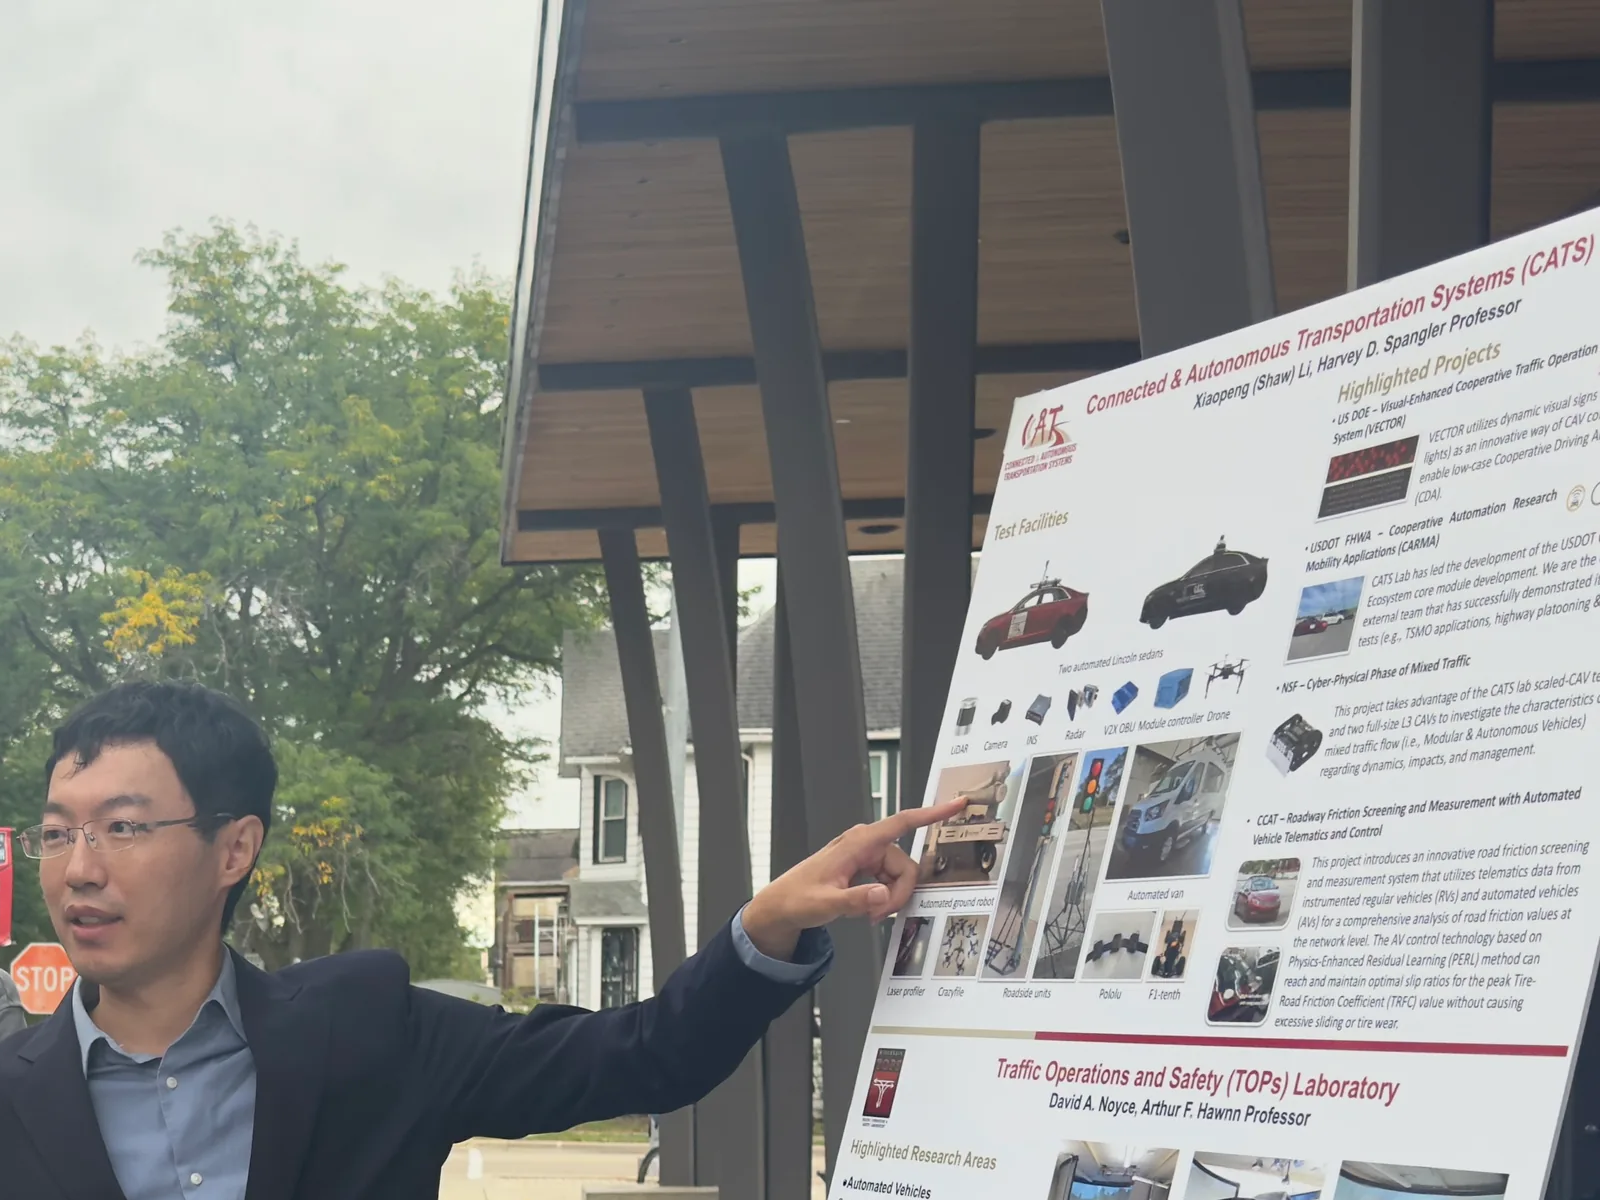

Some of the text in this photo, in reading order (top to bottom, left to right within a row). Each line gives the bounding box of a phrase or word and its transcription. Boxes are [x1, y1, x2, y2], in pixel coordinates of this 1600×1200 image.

[1085, 233, 1596, 415] Connected & Autonomous Transportation Systems (CATS)
[1192, 298, 1522, 409] Xiaopeng (Shaw) Li, Harvey D. Spangler Professor
[1336, 342, 1501, 405] Highlighted Projects
[1336, 343, 1600, 425] US DOE Visual-Enhanced Cooperative Traffic Operation
[993, 510, 1069, 541] Test Facilities
[1058, 648, 1164, 674] Two automated Lincoln sedans
[1137, 712, 1204, 730] Module controller
[1206, 710, 1231, 722] Drone
[982, 740, 1008, 751] Camera
[1064, 728, 1086, 740] Radar
[950, 742, 969, 755] LiDAR
[1256, 785, 1582, 826] CCAT Roadway Friction Screening and Measurement with Automated
[916, 893, 997, 910] Automated ground robot
[1126, 888, 1184, 900] Automated van
[1301, 883, 1579, 908] instrumented regular vehicles (RVs) and automated vehicles
[16, 966, 74, 992] STOP
[885, 985, 925, 998] Laser profiler
[1002, 987, 1052, 998] Roadside units
[1098, 988, 1122, 999] Pololu
[1147, 987, 1181, 1000] F1-tenth
[996, 1057, 1400, 1107] Traffic Operations and Safety (TOPs) Laboratory
[1048, 1091, 1083, 1110] David
[1081, 1094, 1094, 1111] A.
[1097, 1095, 1137, 1117] Noyce,
[1140, 1098, 1182, 1117] Arthur
[1182, 1100, 1193, 1118] F.
[1243, 1104, 1312, 1126] Professor
[849, 1138, 997, 1170] Highlighted Research Areas
[845, 1175, 931, 1199] Automated Vehicles
